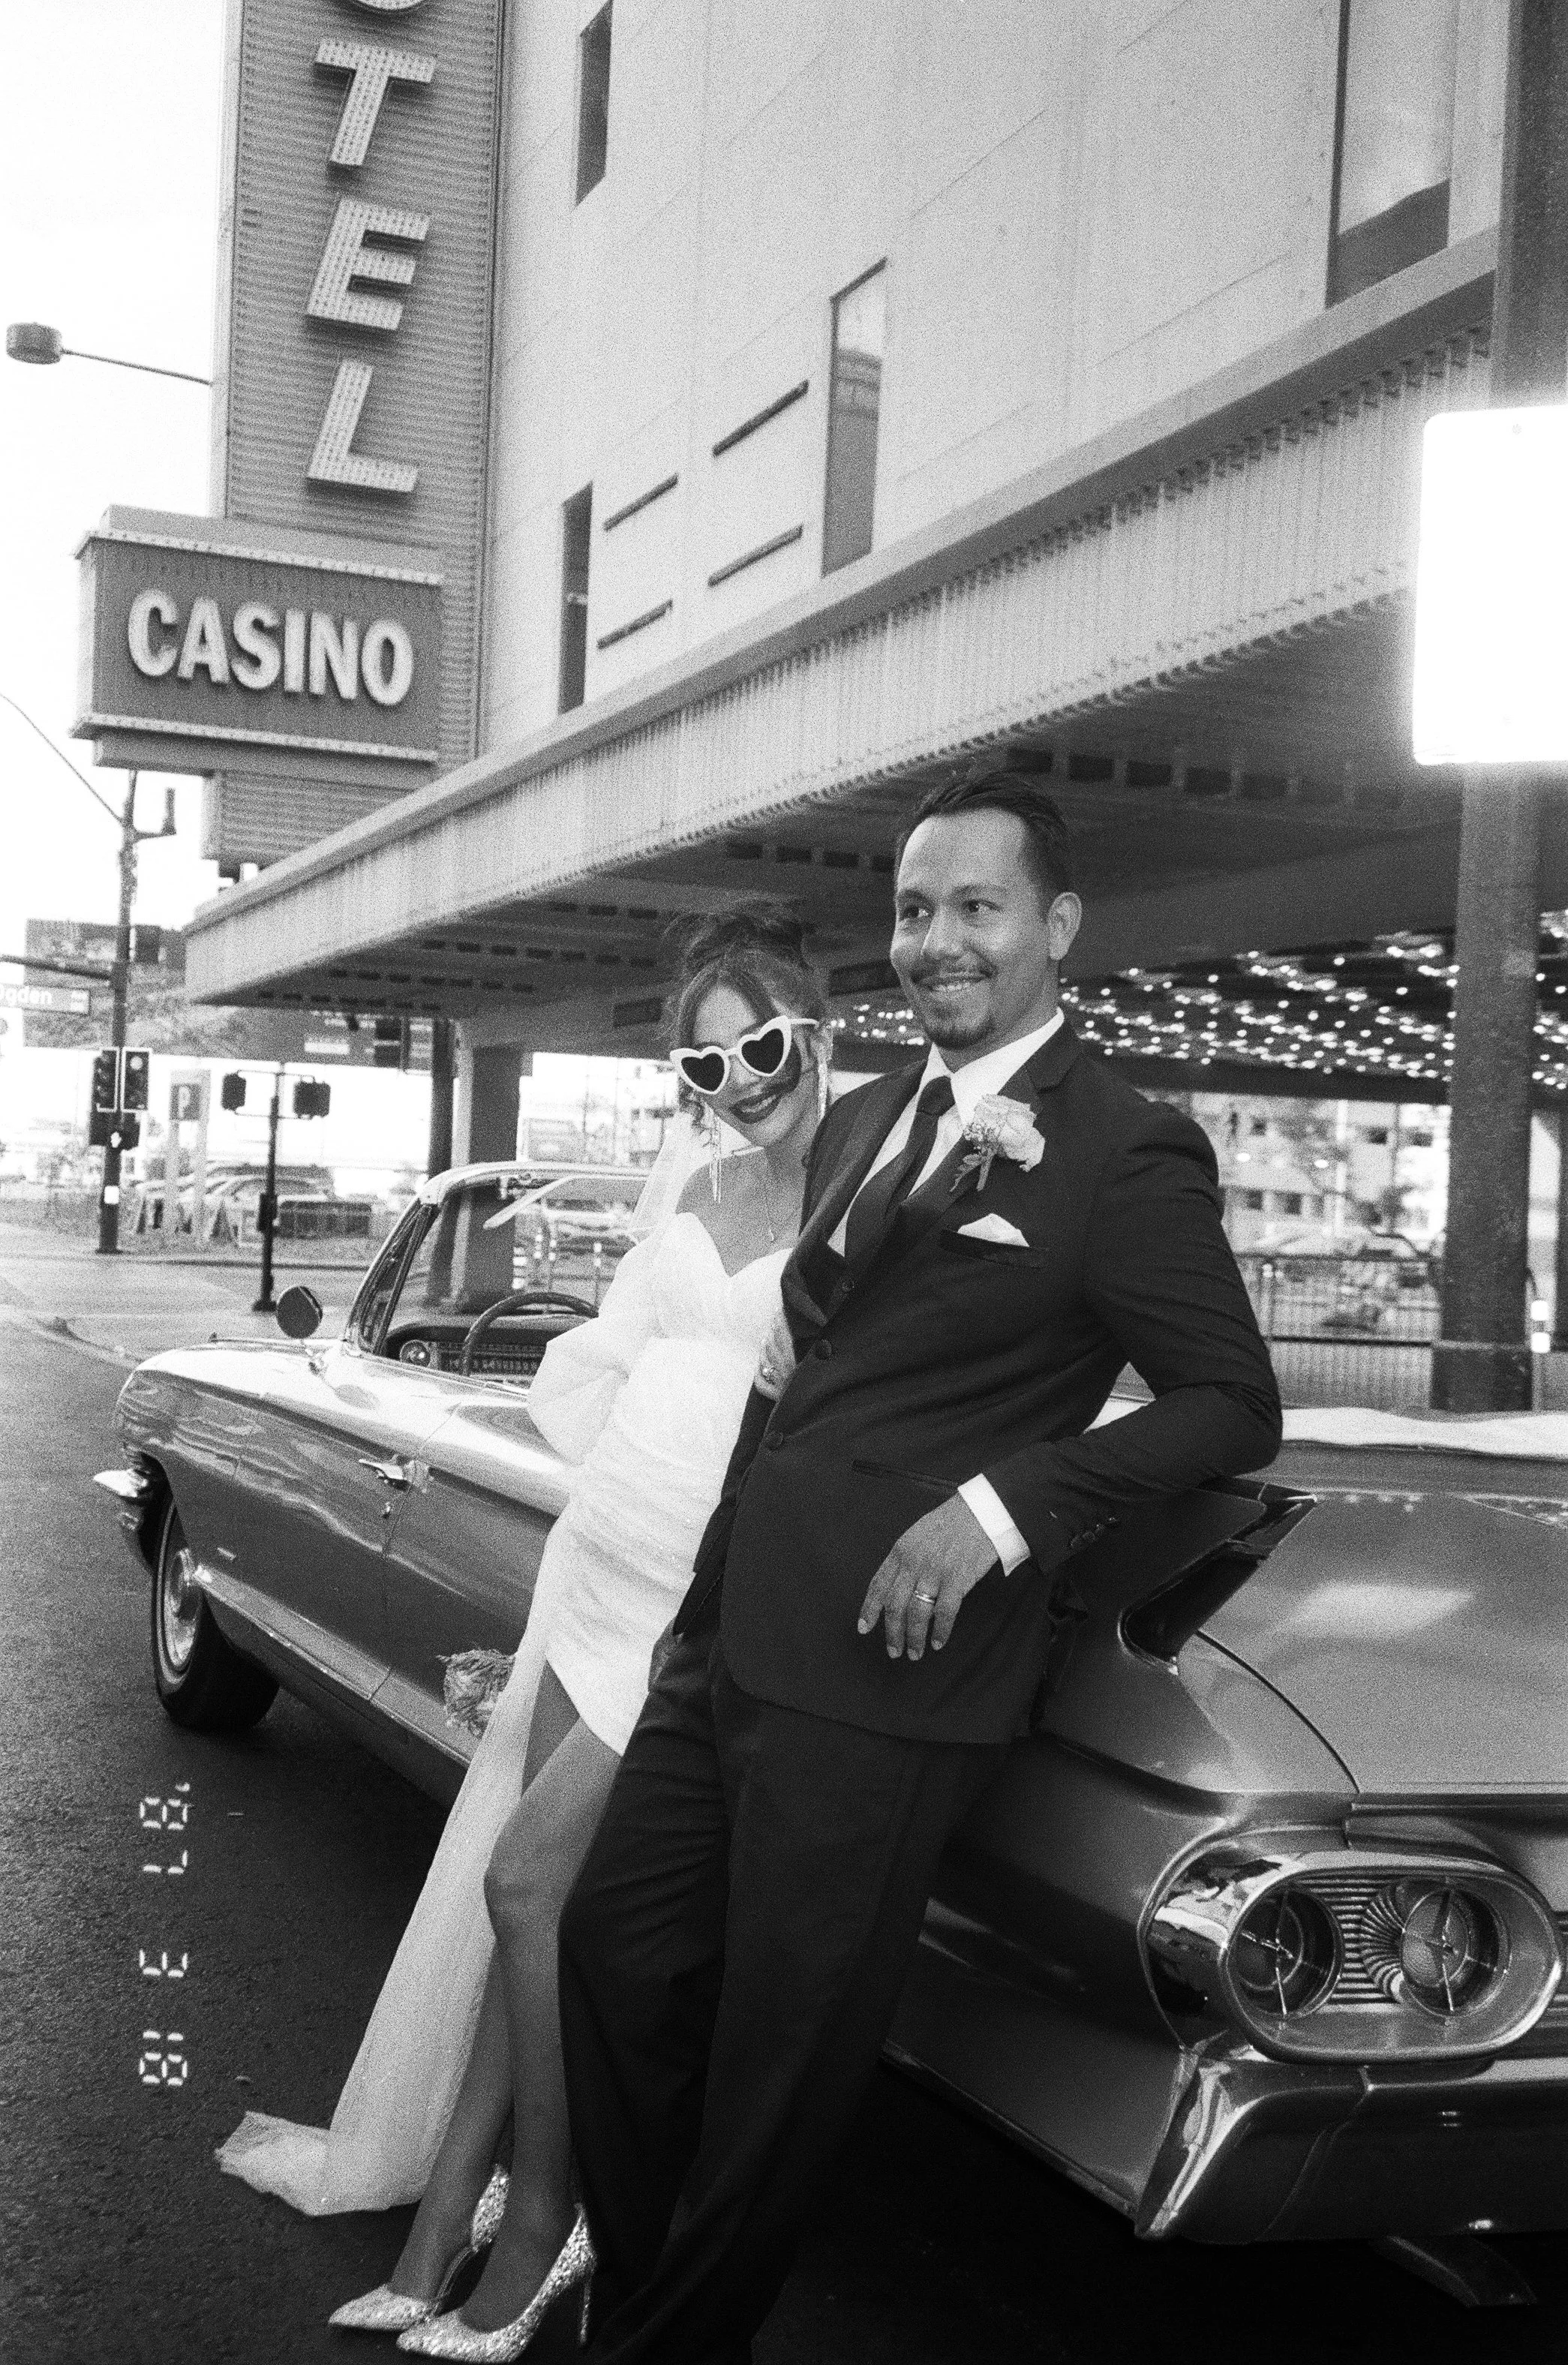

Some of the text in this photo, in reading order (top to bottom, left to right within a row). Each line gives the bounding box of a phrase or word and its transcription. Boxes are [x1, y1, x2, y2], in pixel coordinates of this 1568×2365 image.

[306, 0, 437, 492] TEL
[128, 589, 413, 706] CASINO
[177, 1086, 191, 1118] P
